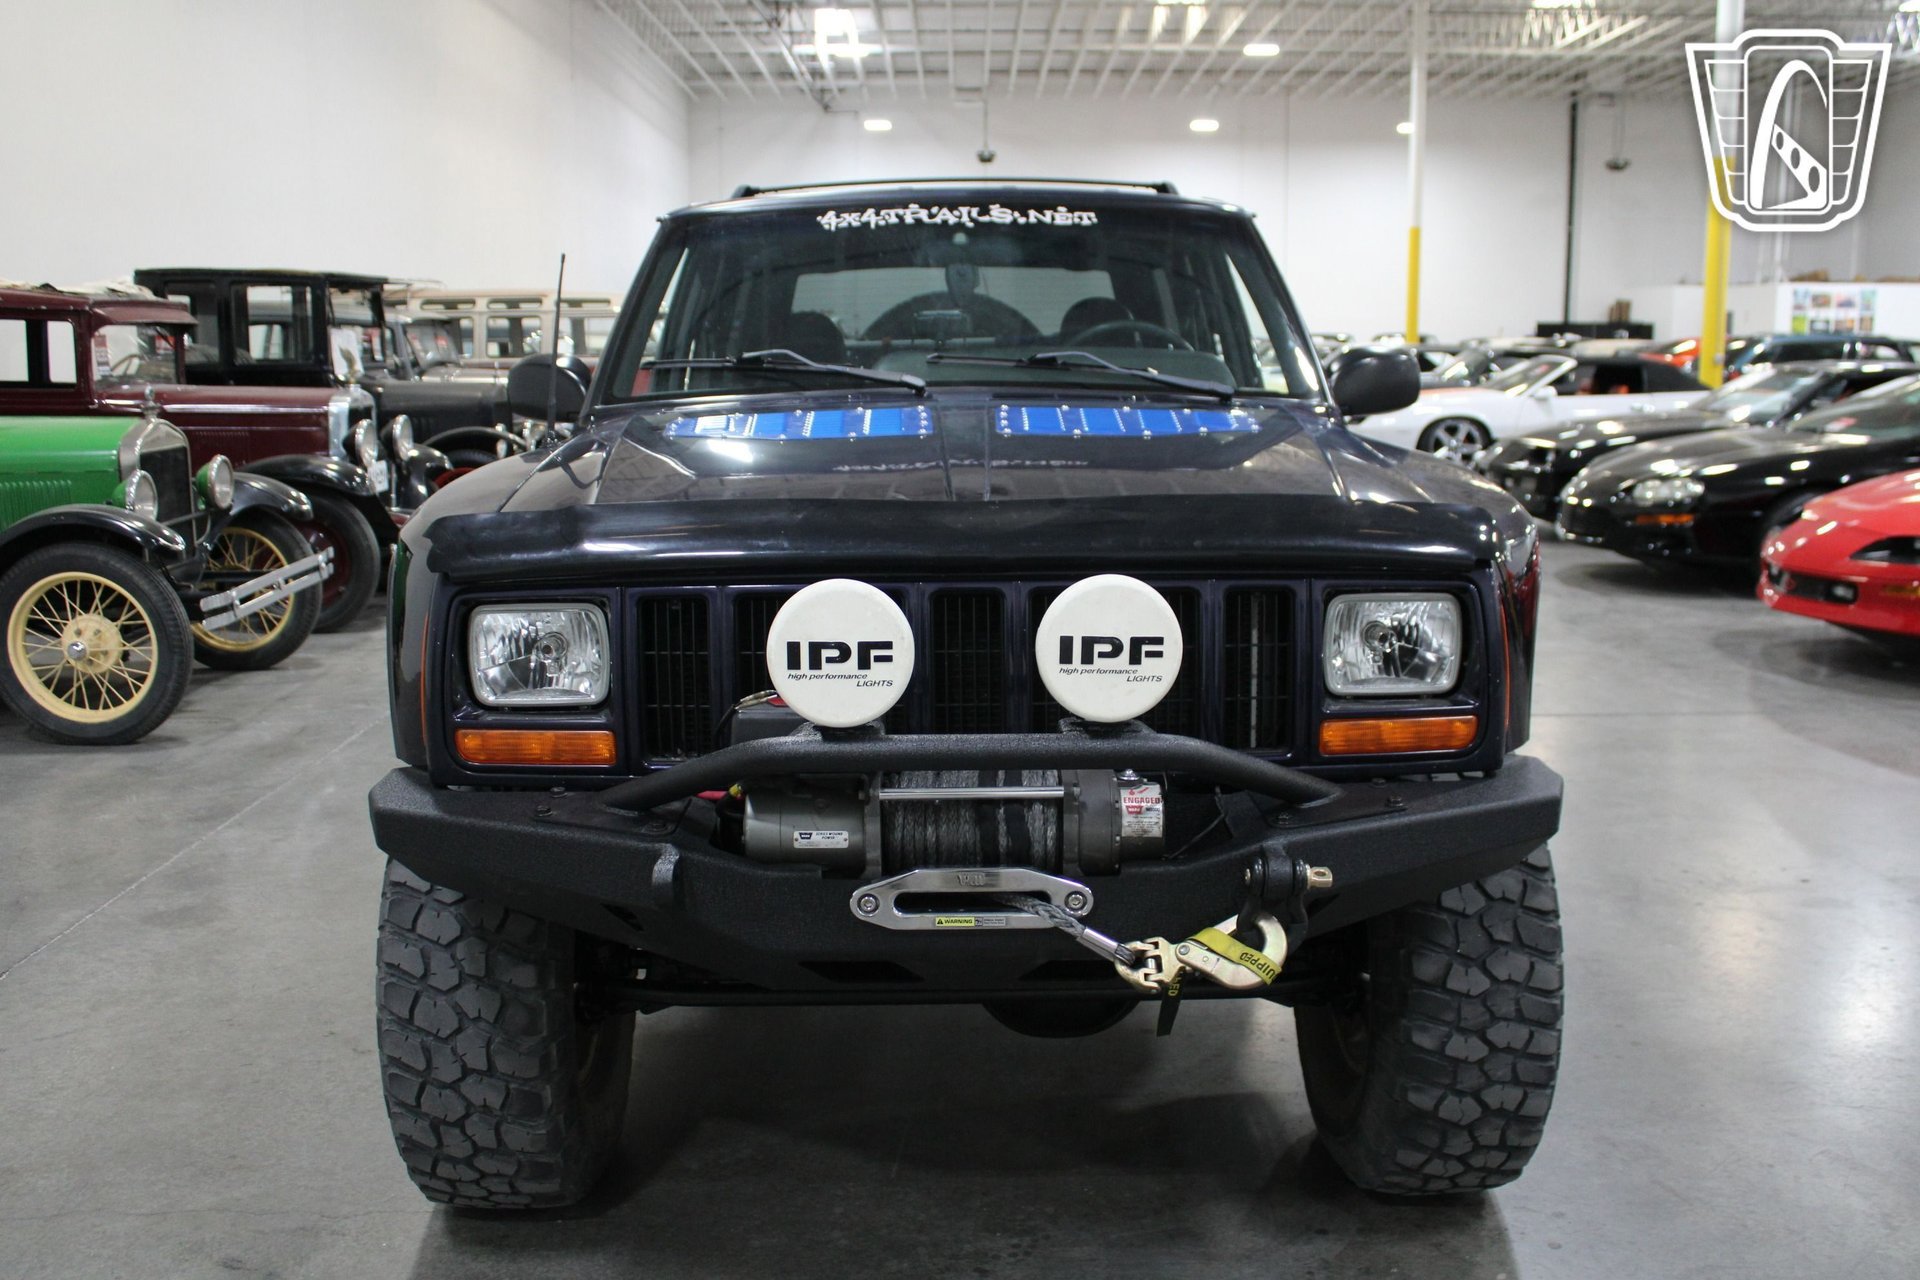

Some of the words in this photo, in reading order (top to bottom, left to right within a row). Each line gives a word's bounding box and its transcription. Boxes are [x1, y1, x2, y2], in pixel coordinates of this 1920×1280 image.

[786, 640, 894, 671] IPF
[1059, 635, 1164, 665] IPF
[787, 672, 808, 681] high
[808, 672, 868, 681] performance
[1058, 667, 1079, 676] high
[1079, 667, 1138, 675] performance
